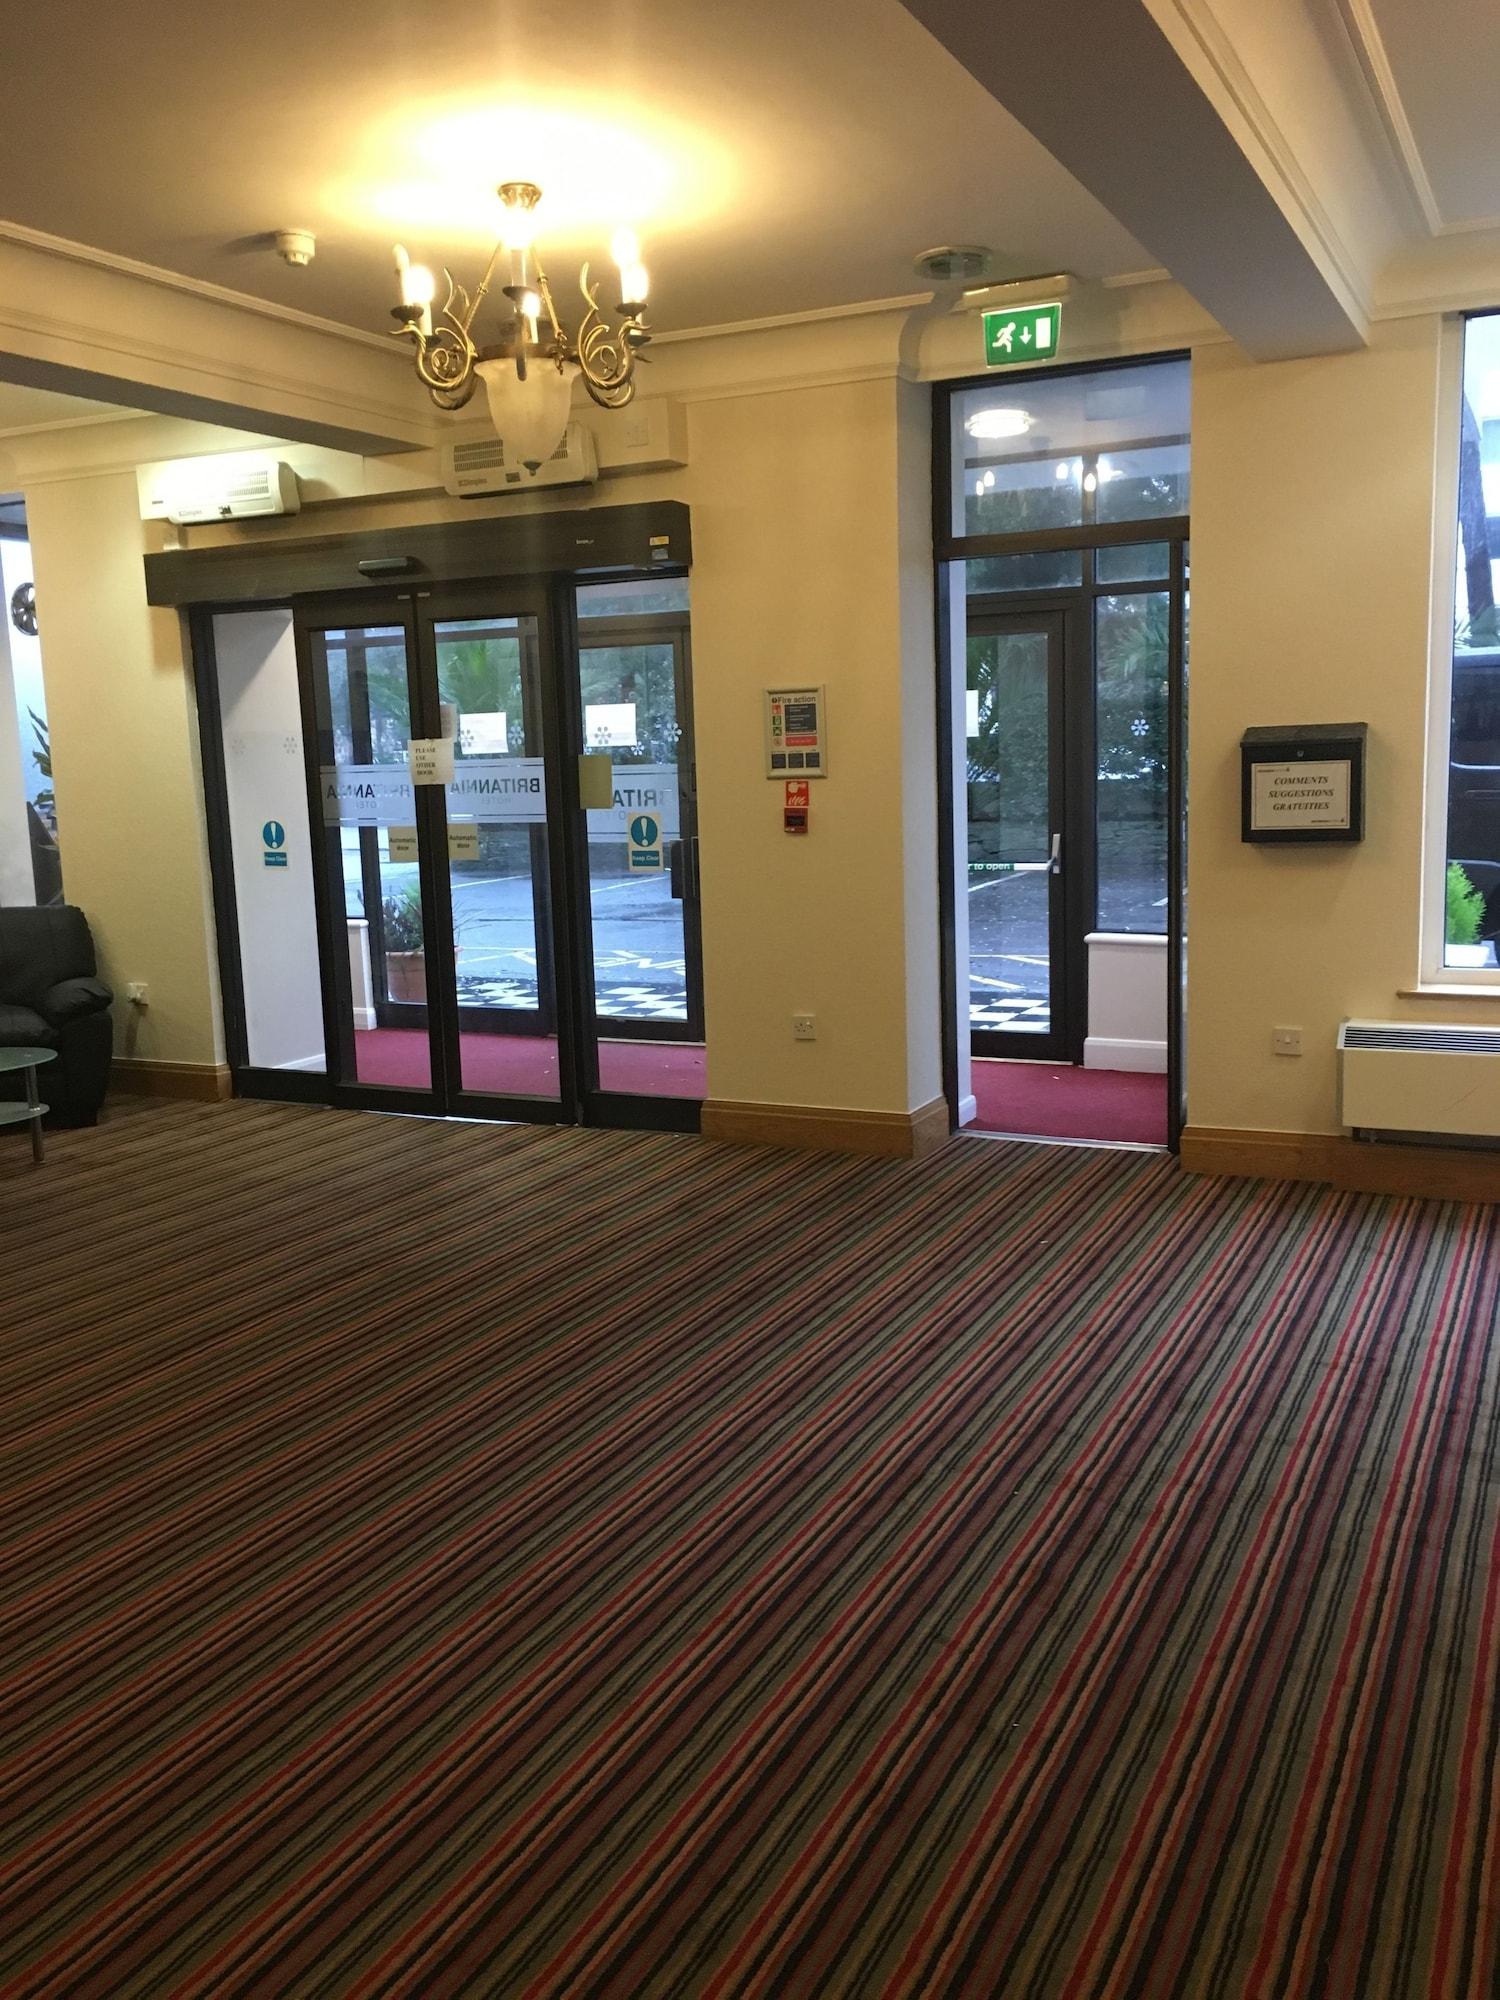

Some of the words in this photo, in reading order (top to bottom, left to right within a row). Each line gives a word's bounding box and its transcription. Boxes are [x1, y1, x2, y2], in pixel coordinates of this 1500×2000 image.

[793, 695, 816, 703] action
[1274, 776, 1329, 785] COMMENTS
[1268, 788, 1335, 798] SUGGESTIONS
[1272, 802, 1330, 811] GRATUITIES
